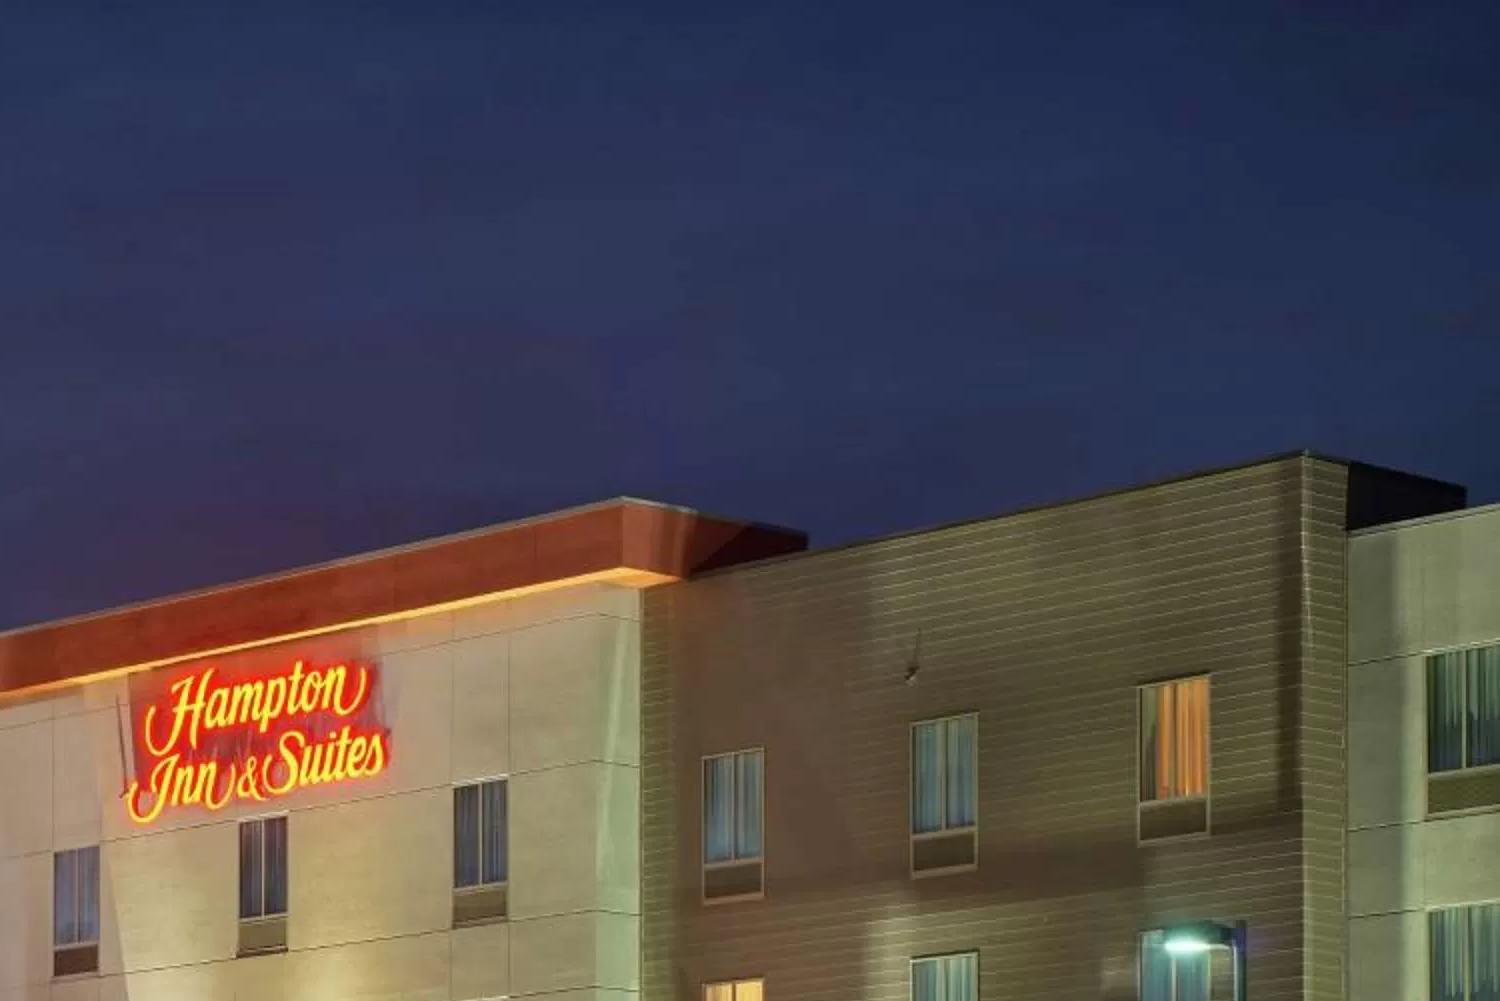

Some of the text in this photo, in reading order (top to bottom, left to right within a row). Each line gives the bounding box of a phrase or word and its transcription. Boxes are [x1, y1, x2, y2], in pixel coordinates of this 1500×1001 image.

[145, 660, 366, 756] Hampton
[127, 726, 383, 823] Inn & Suites
